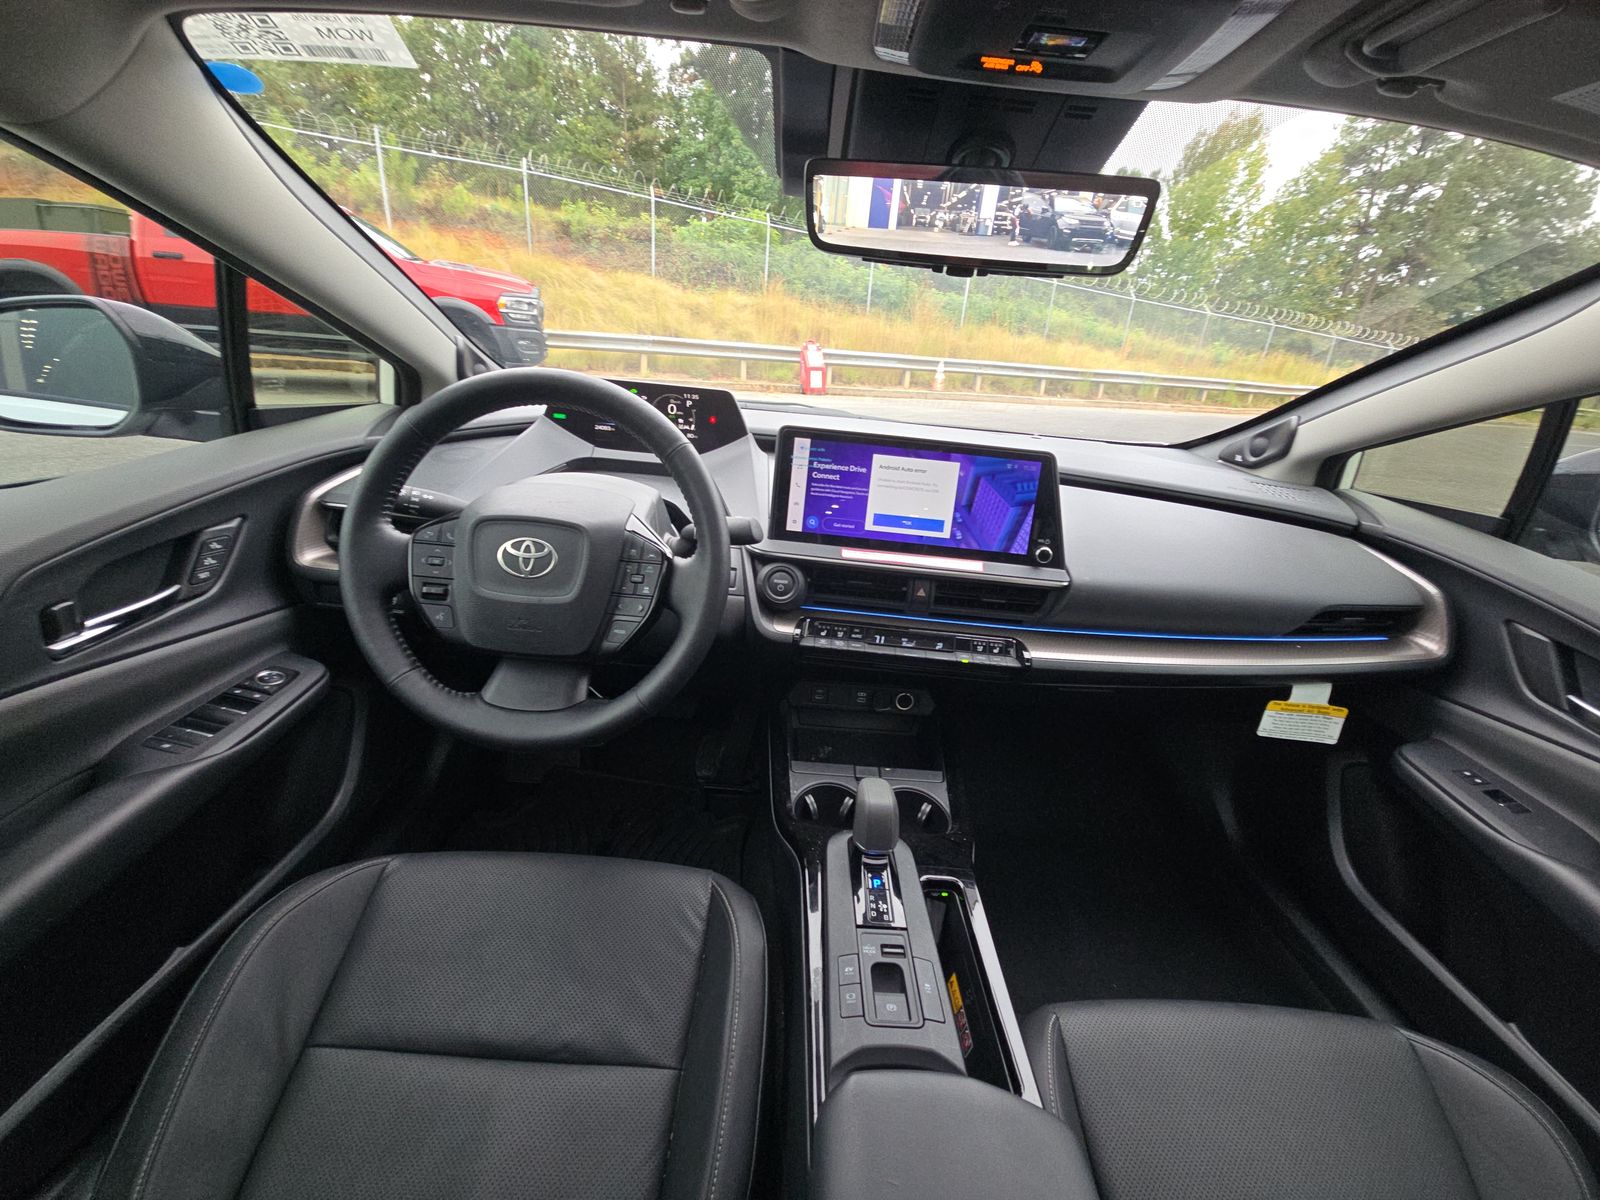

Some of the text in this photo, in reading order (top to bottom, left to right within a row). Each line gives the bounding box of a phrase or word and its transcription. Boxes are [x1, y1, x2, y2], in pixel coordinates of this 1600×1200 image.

[314, 26, 375, 42] MOW
[667, 404, 677, 415] 0
[813, 461, 867, 473] Experience Drive
[811, 471, 841, 481] Connect
[873, 879, 881, 888] P
